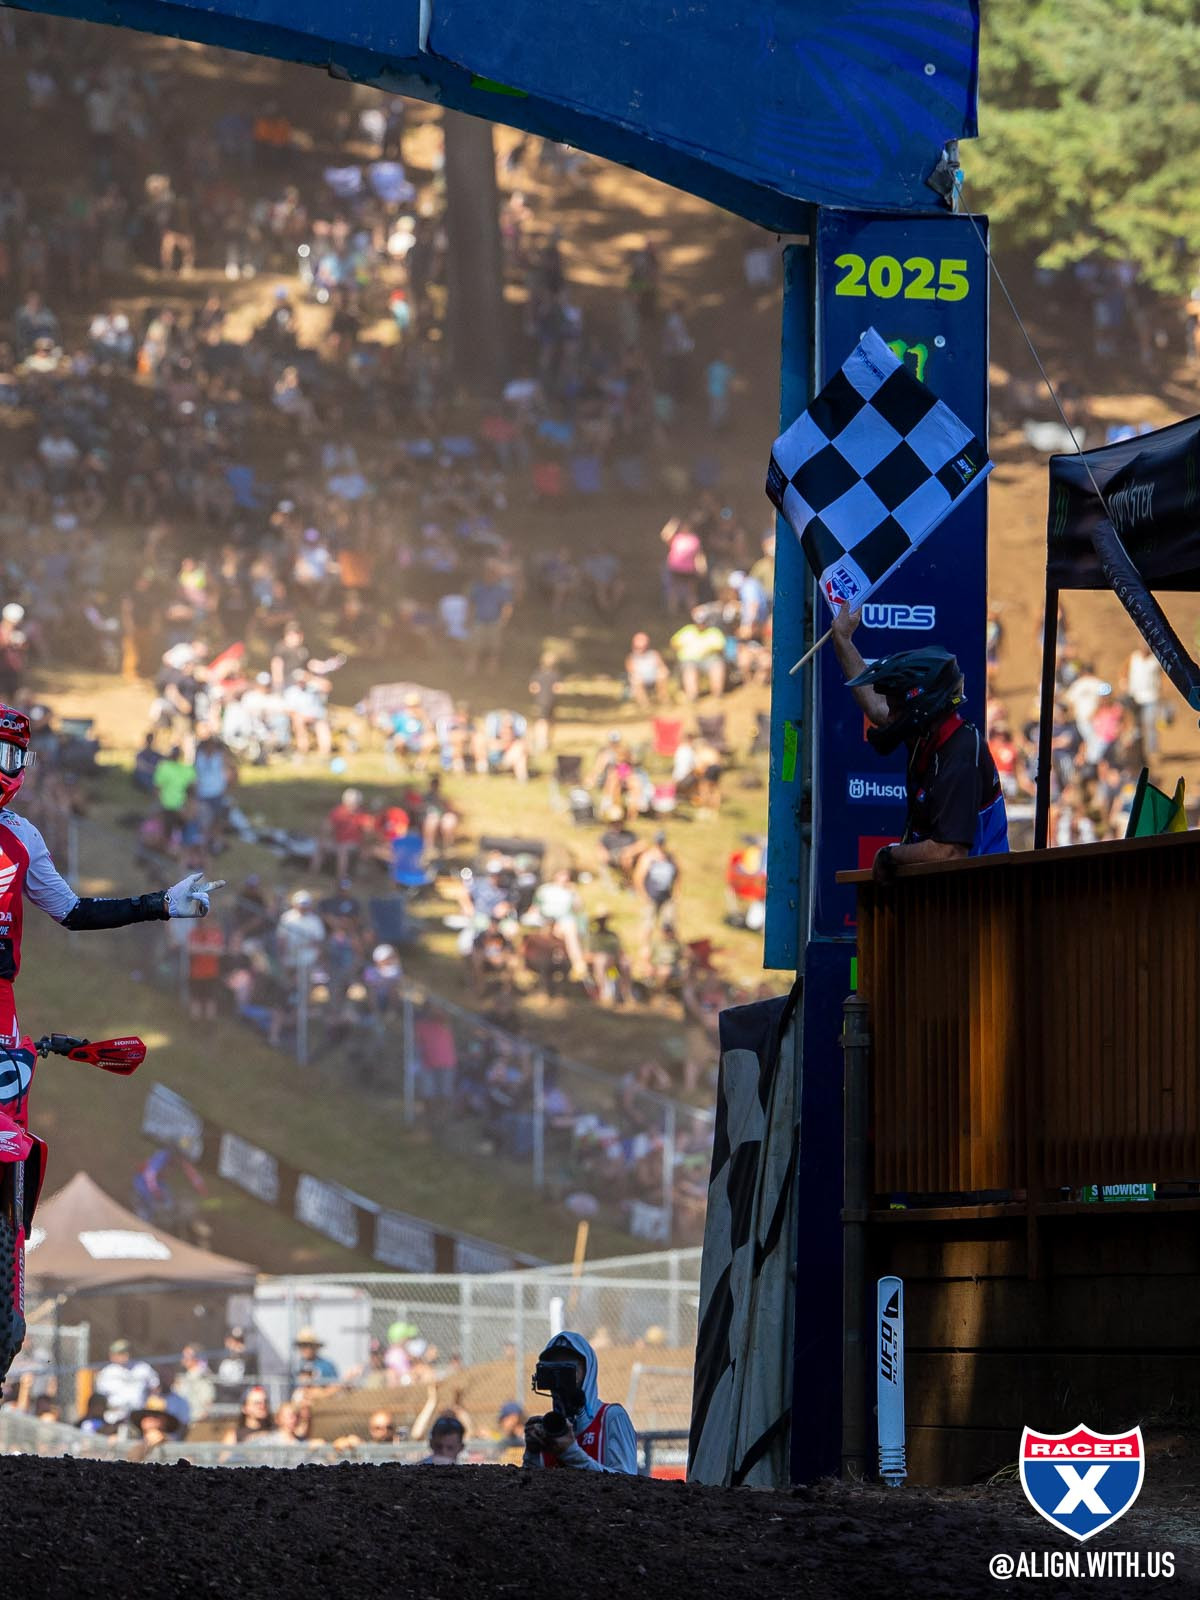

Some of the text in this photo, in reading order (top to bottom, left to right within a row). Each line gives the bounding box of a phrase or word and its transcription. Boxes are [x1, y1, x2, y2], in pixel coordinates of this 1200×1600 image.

[834, 253, 969, 302] 2025
[863, 604, 935, 630] WPS
[881, 1319, 893, 1382] UFO
[582, 1432, 596, 1446] 25
